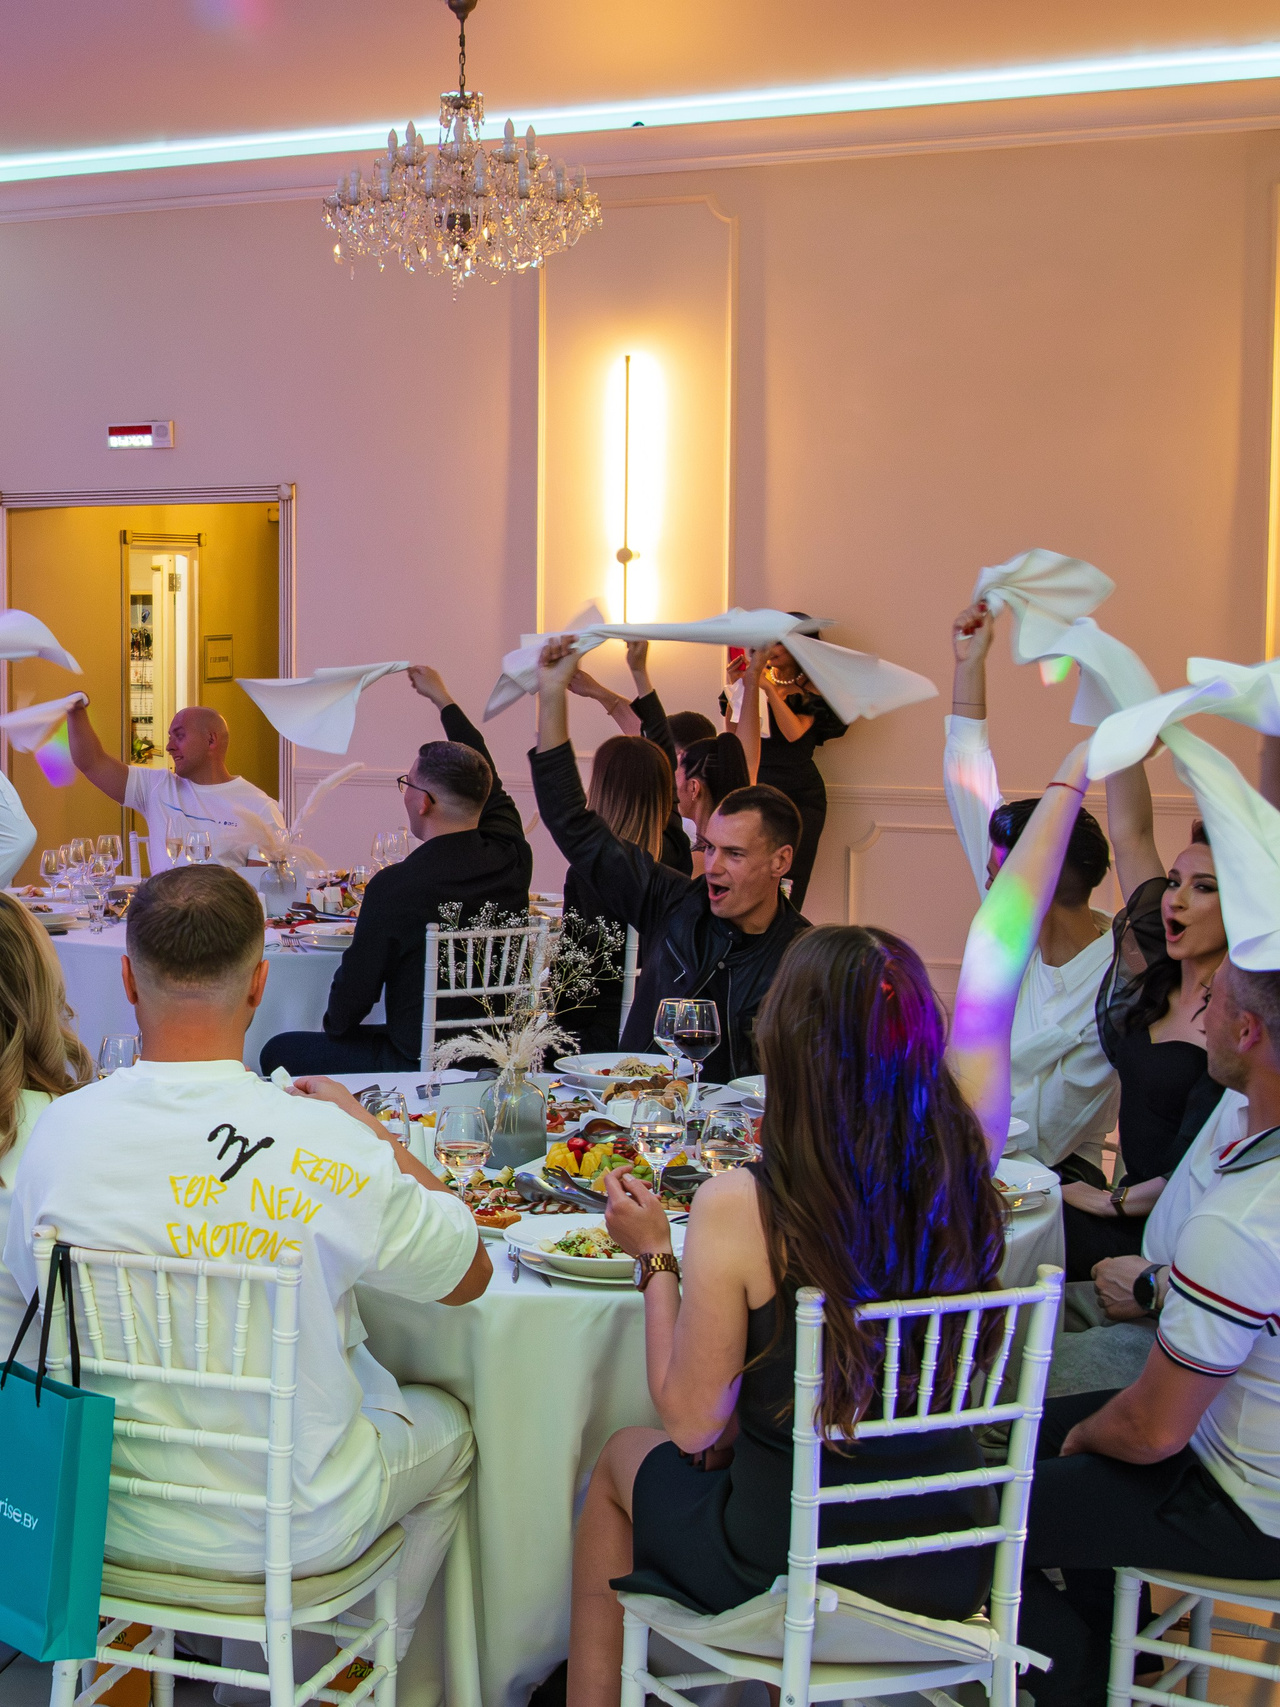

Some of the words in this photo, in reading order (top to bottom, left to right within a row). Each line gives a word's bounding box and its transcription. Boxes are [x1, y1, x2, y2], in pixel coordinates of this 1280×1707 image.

[290, 1147, 371, 1199] READY
[168, 1174, 228, 1208] FOR
[250, 1177, 323, 1224] NEW
[166, 1221, 303, 1263] EMOTIONS
